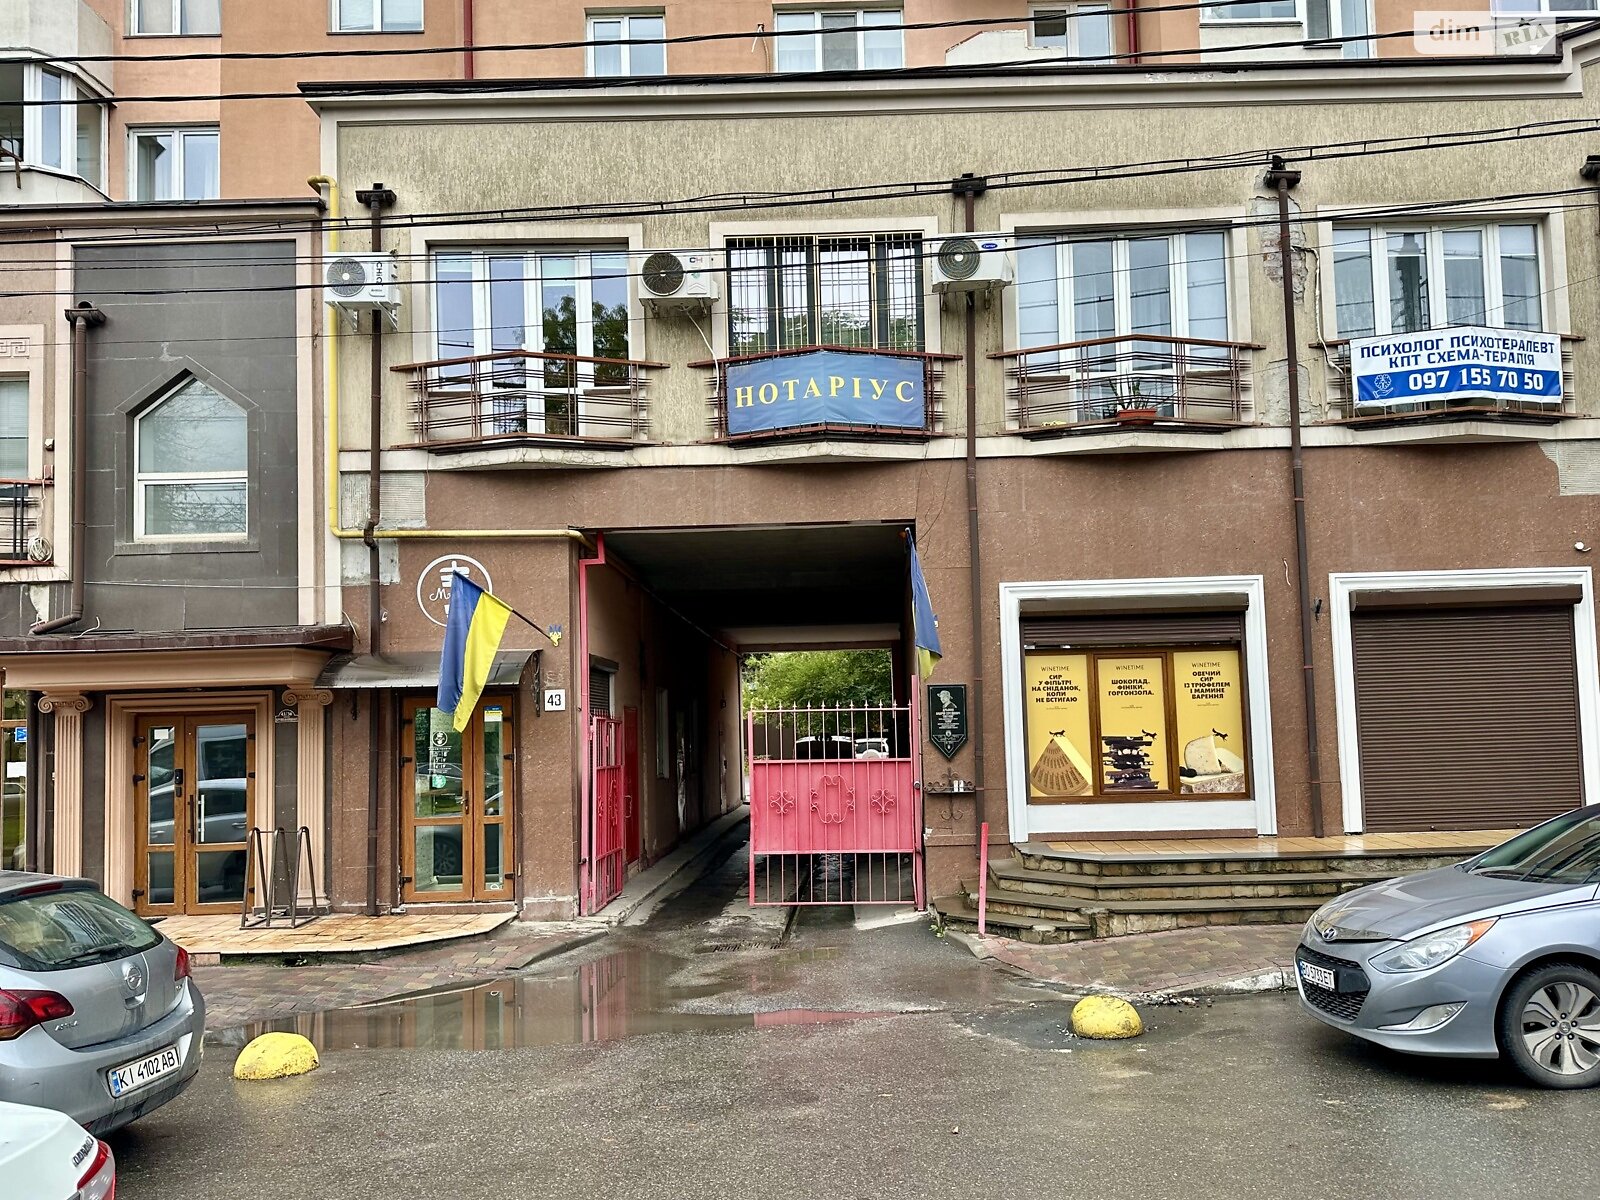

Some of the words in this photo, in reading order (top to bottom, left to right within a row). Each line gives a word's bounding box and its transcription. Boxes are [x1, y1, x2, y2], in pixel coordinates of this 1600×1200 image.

[1361, 338, 1444, 358] ПСИХОЛОГ
[1450, 335, 1555, 354] ПСИХОТЕРАПЕВТ
[1389, 353, 1420, 369] КПТ
[1427, 349, 1535, 366] СХЕМА-ТЕРАПІЯ
[1408, 370, 1450, 391] 097
[1458, 367, 1492, 387] 155
[1496, 370, 1519, 389] 70
[1523, 372, 1544, 391] 50
[735, 375, 915, 409] НОТАРІУС
[547, 694, 562, 706] 43
[118, 1068, 134, 1089] KI
[137, 1057, 161, 1080] 4102
[161, 1051, 176, 1071] AB
